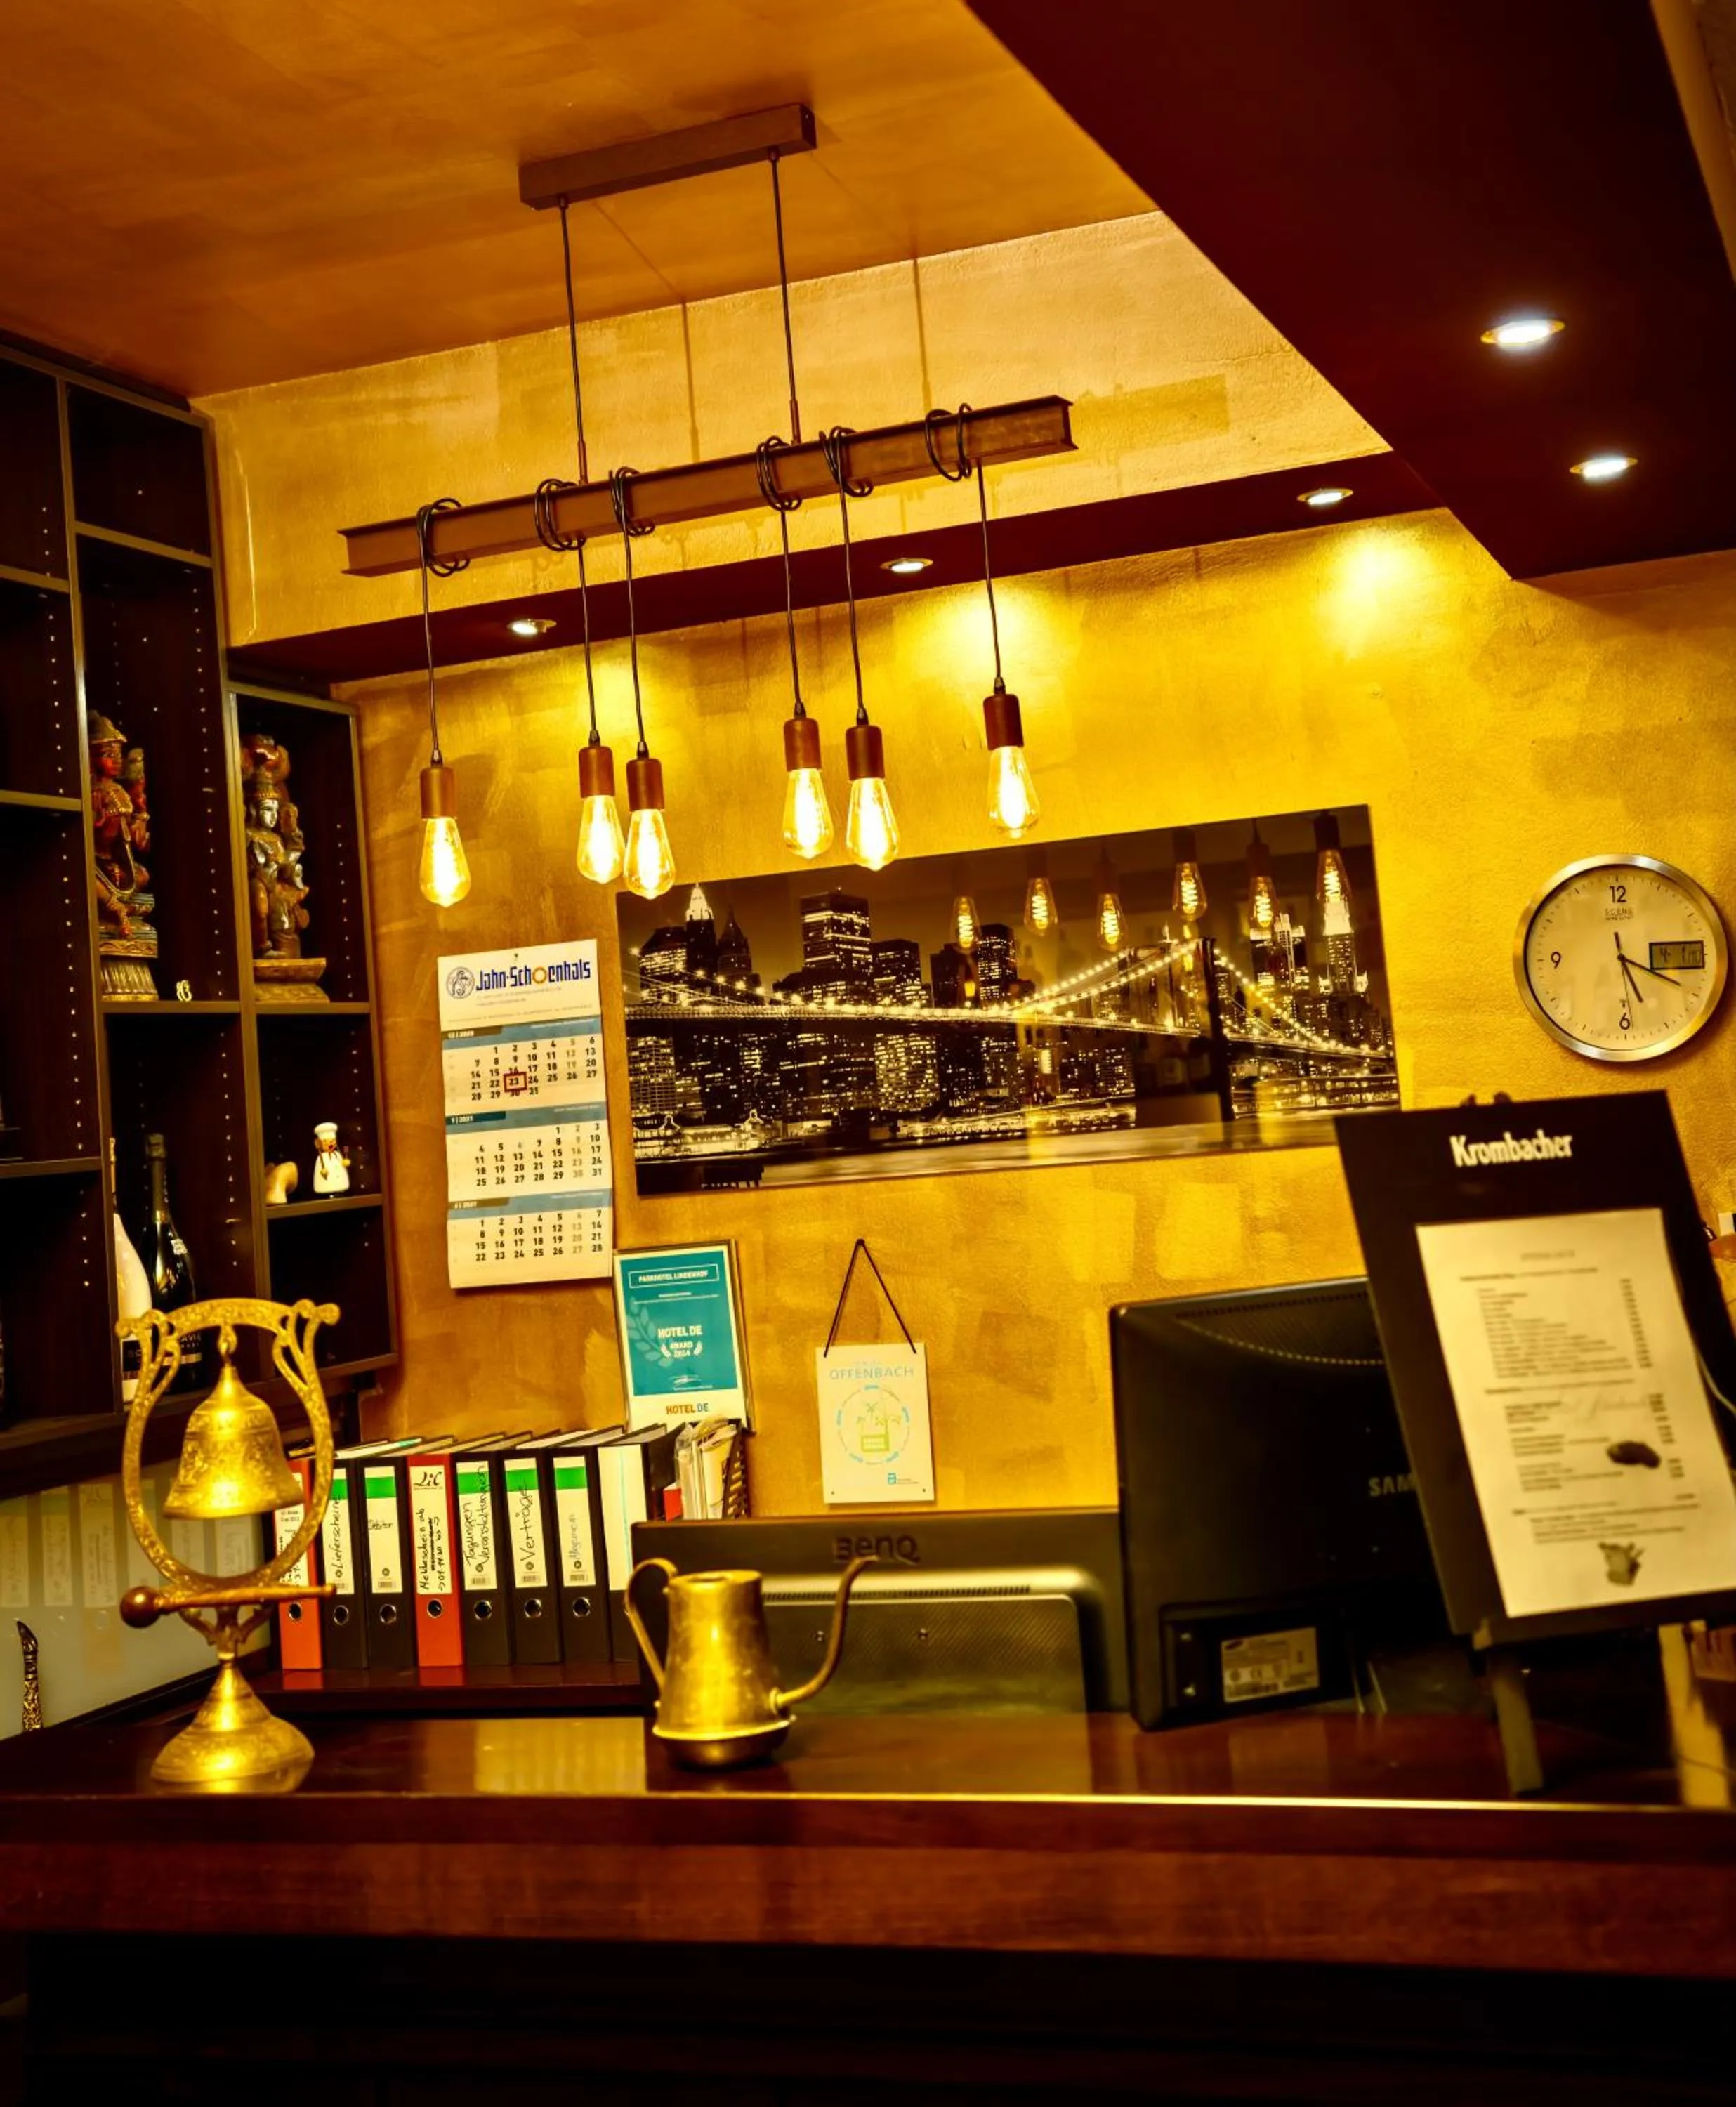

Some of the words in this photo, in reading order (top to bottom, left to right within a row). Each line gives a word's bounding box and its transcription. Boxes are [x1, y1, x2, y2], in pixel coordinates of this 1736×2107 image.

[1609, 885, 1627, 904] 12
[1550, 951, 1562, 969] 9
[1619, 1012, 1631, 1030] 6
[490, 1068, 499, 1077] 15
[586, 1058, 596, 1067] 20
[586, 1070, 597, 1078] 27
[491, 1090, 501, 1098] 29
[1450, 1129, 1573, 1167] Krombacher
[534, 1162, 543, 1170] 21
[515, 1174, 525, 1183] 27
[534, 1173, 544, 1181] 28
[476, 1253, 485, 1261] 22
[495, 1252, 505, 1260] 23
[592, 1244, 603, 1252] 28
[829, 1366, 914, 1380] OFFENBACH
[665, 1404, 696, 1415] HOTEL
[696, 1403, 709, 1412] DE
